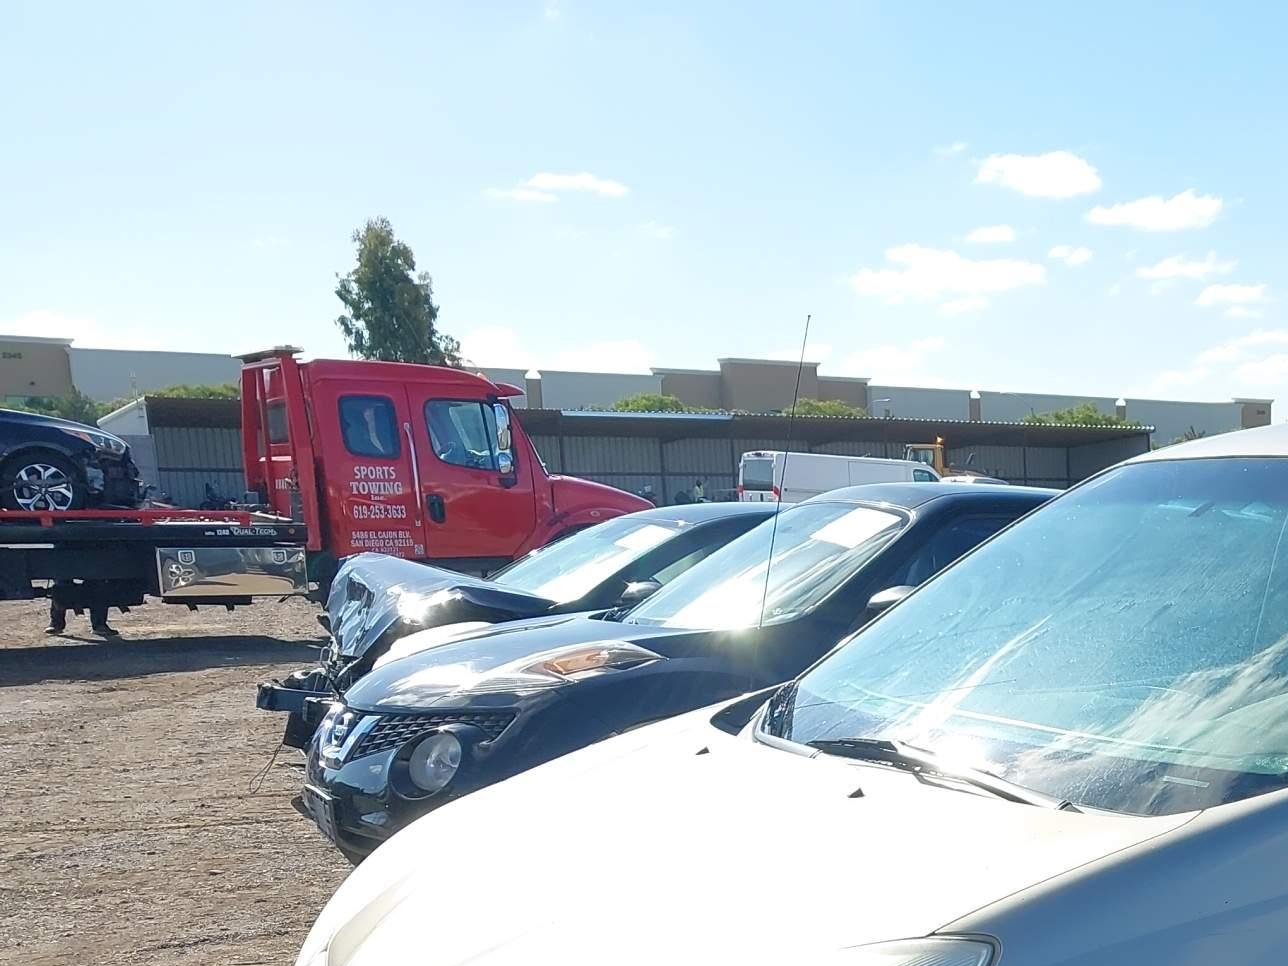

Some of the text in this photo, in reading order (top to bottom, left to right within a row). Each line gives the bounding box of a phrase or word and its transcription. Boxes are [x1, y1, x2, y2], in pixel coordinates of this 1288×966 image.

[354, 466, 396, 479] SPORTS
[350, 482, 403, 495] TOWING
[353, 505, 407, 518] 619-253-3633
[369, 531, 377, 539] EL
[377, 531, 397, 539] CAJON
[351, 539, 364, 547] SAN
[364, 539, 384, 547] DIEGO
